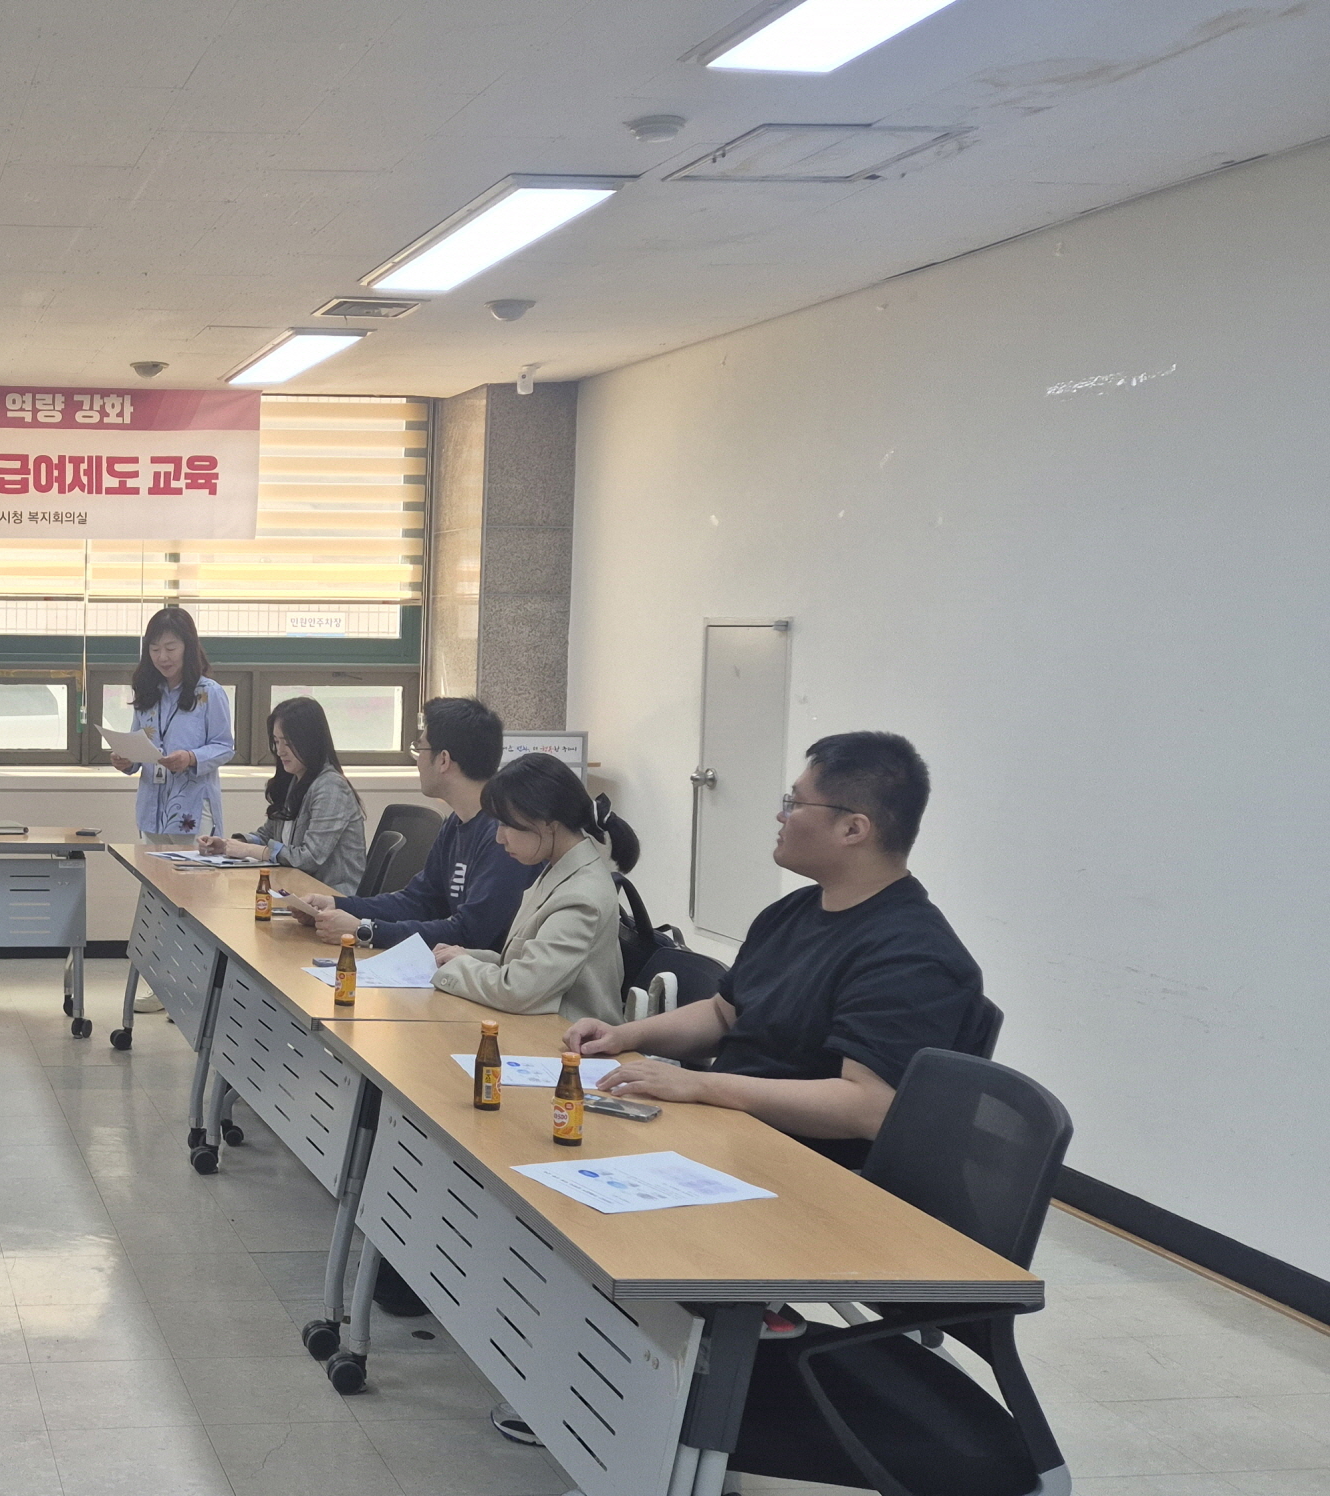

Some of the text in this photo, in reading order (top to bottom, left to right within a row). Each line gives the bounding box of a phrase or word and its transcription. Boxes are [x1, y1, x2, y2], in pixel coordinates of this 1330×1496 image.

[5, 393, 65, 423] 역량
[73, 394, 133, 424] 강화
[147, 455, 219, 496] 교육
[27, 511, 88, 525] 복지회의실
